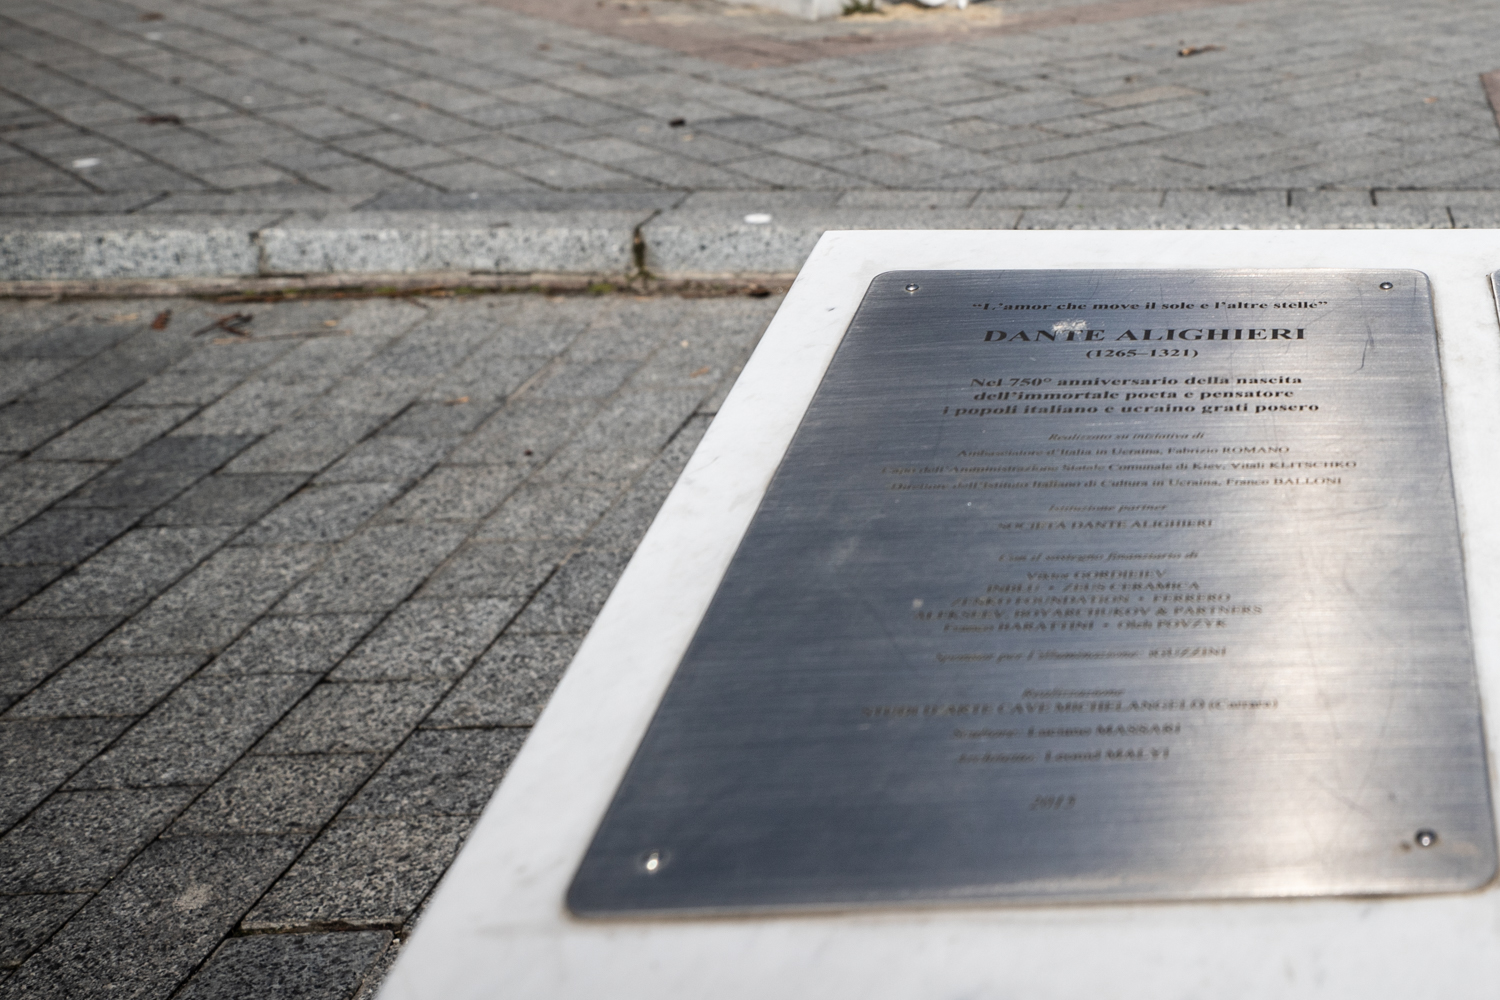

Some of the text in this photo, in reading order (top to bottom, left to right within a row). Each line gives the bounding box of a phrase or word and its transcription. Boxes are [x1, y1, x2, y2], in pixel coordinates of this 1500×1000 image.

[1057, 302, 1086, 310] che
[1092, 302, 1139, 310] move
[1145, 301, 1155, 310] il
[1161, 301, 1194, 310] sole
[1200, 302, 1210, 310] e
[984, 328, 1306, 342] DANTE ALIGHIERI
[970, 378, 1001, 387] Nel
[1057, 378, 1178, 386] anniversario
[1184, 377, 1229, 385] della
[1236, 376, 1302, 384] nascita
[1125, 391, 1177, 400] poeta
[1184, 391, 1193, 399] e
[1199, 390, 1294, 399] pensatore
[942, 404, 1319, 416] i popoli italiano e ucraino grati posero
[1222, 446, 1290, 454] ROMANO
[1269, 461, 1356, 469] KLITSCHKO
[1274, 477, 1341, 485] BALLONI
